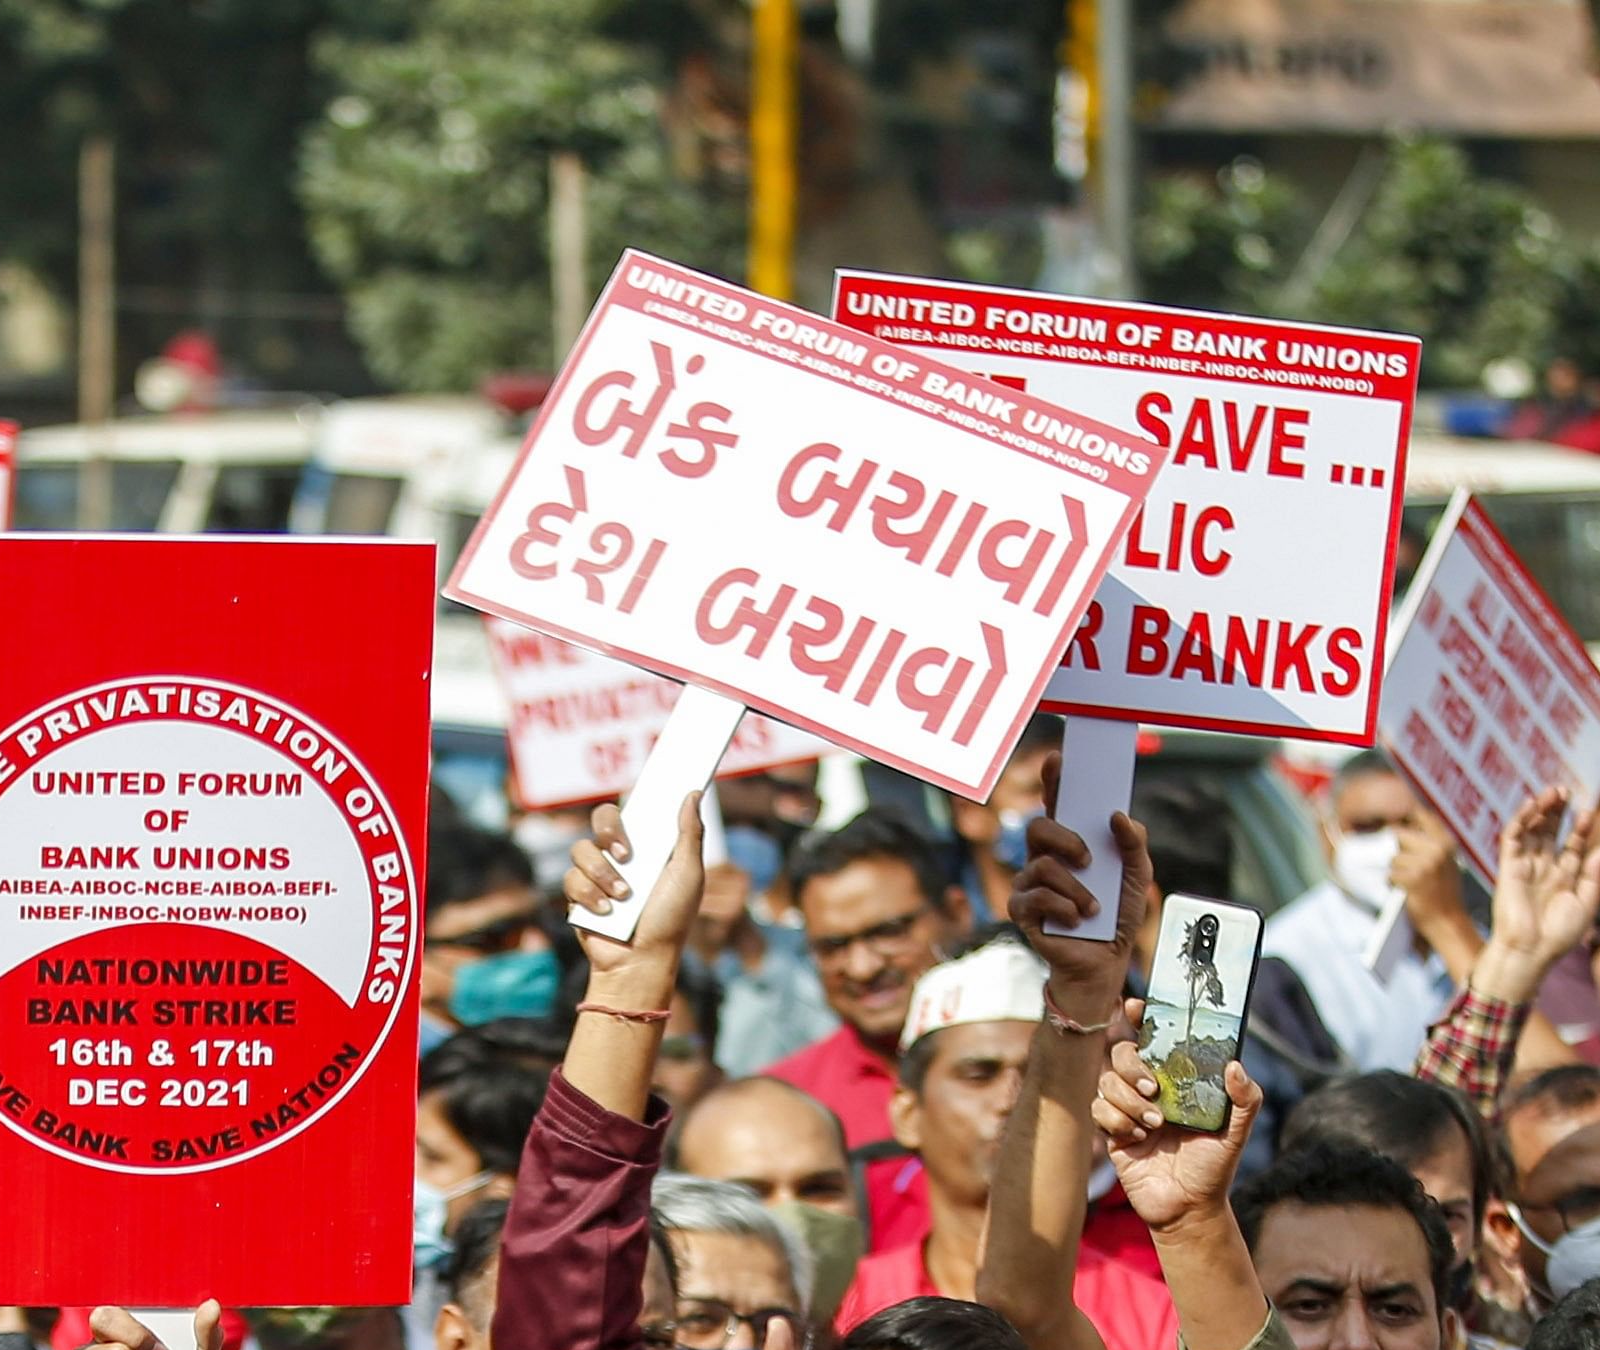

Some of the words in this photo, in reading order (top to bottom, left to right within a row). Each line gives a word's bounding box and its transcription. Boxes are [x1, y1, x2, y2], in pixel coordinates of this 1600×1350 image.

[626, 266, 747, 322] UNITED
[750, 310, 868, 366] FORUM
[871, 354, 913, 382] OF
[921, 371, 1019, 424] BANK
[1022, 409, 1151, 475] UNIONS
[847, 291, 975, 327] UNITED
[985, 307, 1107, 343] FORUM
[1116, 323, 1161, 349] OF
[1172, 329, 1266, 363] BANK
[1277, 340, 1408, 377] UNIONS
[1135, 391, 1311, 479] SAVE
[572, 340, 739, 479] બેંક
[777, 443, 1089, 617] બચાવો
[1126, 502, 1235, 576] LIC
[509, 464, 667, 614] દેશ
[695, 568, 1007, 747] બચાવો
[1126, 604, 1362, 697] BANKS
[16, 686, 349, 786] PRIVATISATION
[32, 771, 166, 797] UNITED
[177, 772, 303, 798] FORUM
[346, 784, 394, 843] OF
[40, 847, 140, 871] BANK
[154, 847, 291, 871] UNIONS
[143, 810, 189, 834] OF
[19, 904, 307, 925] INBEF-INBOC-NOBW-NOBO)
[366, 850, 404, 1006] BANKS
[36, 958, 289, 986] NATIONWIDE
[27, 1000, 140, 1026] BANK
[152, 1000, 297, 1026] STRIKE
[49, 1040, 134, 1068] 16th
[148, 1042, 175, 1067] &
[190, 1040, 274, 1068] 17th
[32, 1108, 130, 1160] BANK
[152, 1128, 245, 1162] SAVE
[250, 1043, 363, 1141] NATION
[69, 1079, 147, 1107] DEC
[160, 1079, 250, 1107] 2021
